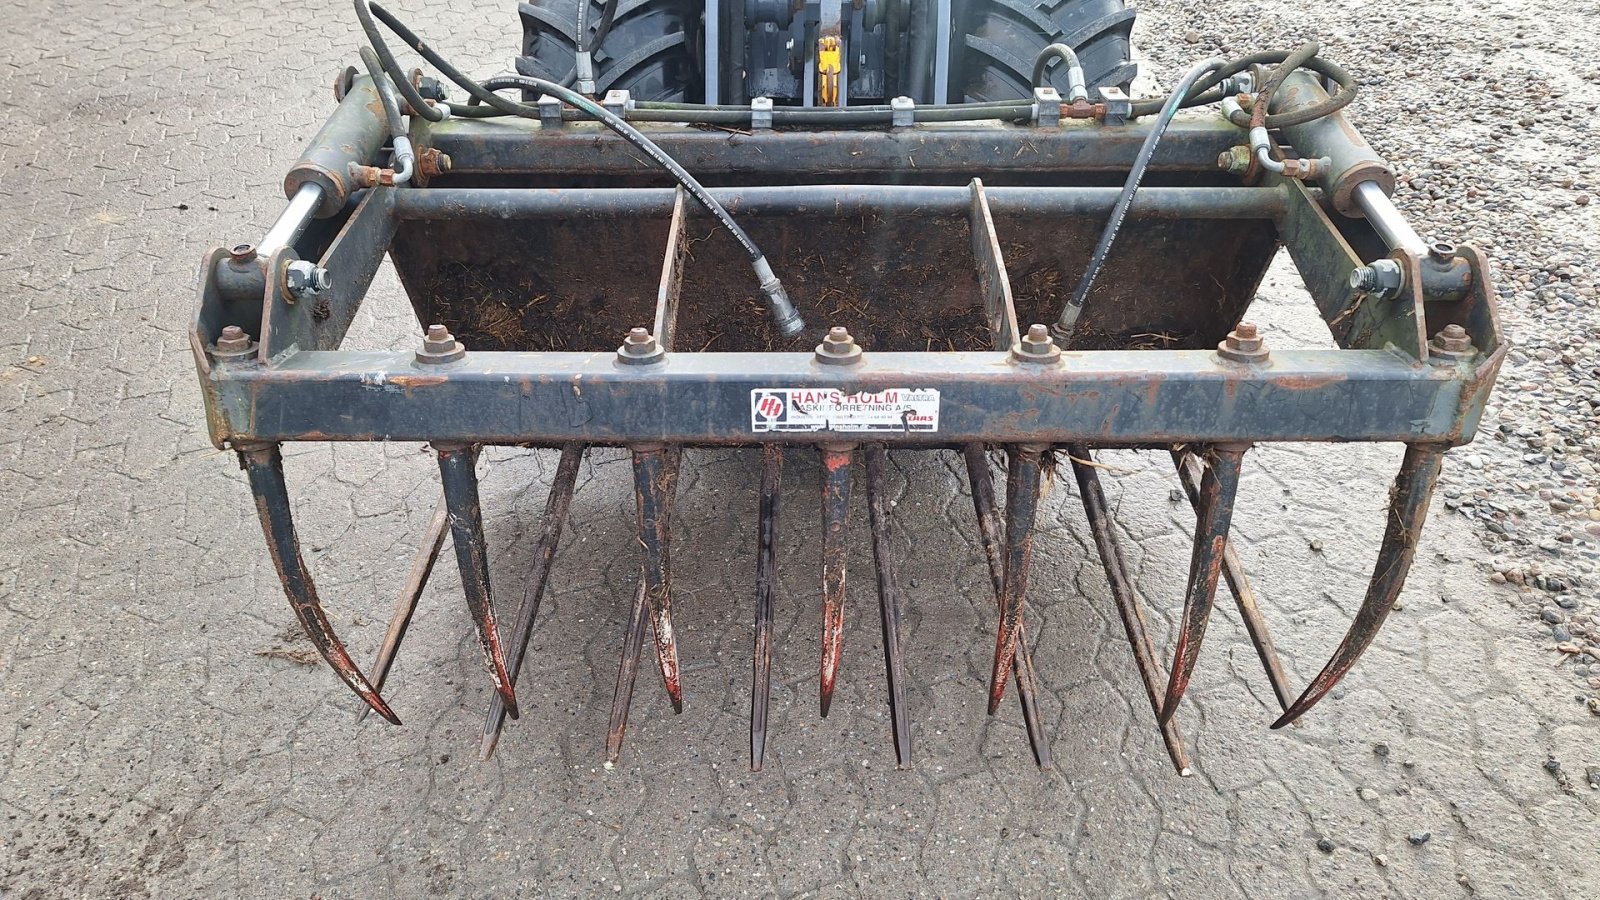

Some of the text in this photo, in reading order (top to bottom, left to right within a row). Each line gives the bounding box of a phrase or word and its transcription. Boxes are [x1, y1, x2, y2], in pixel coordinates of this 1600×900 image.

[791, 391, 898, 404] HANS HOLM
[901, 393, 936, 402] VALTRA
[791, 403, 892, 412] ASKIFORRETNING
